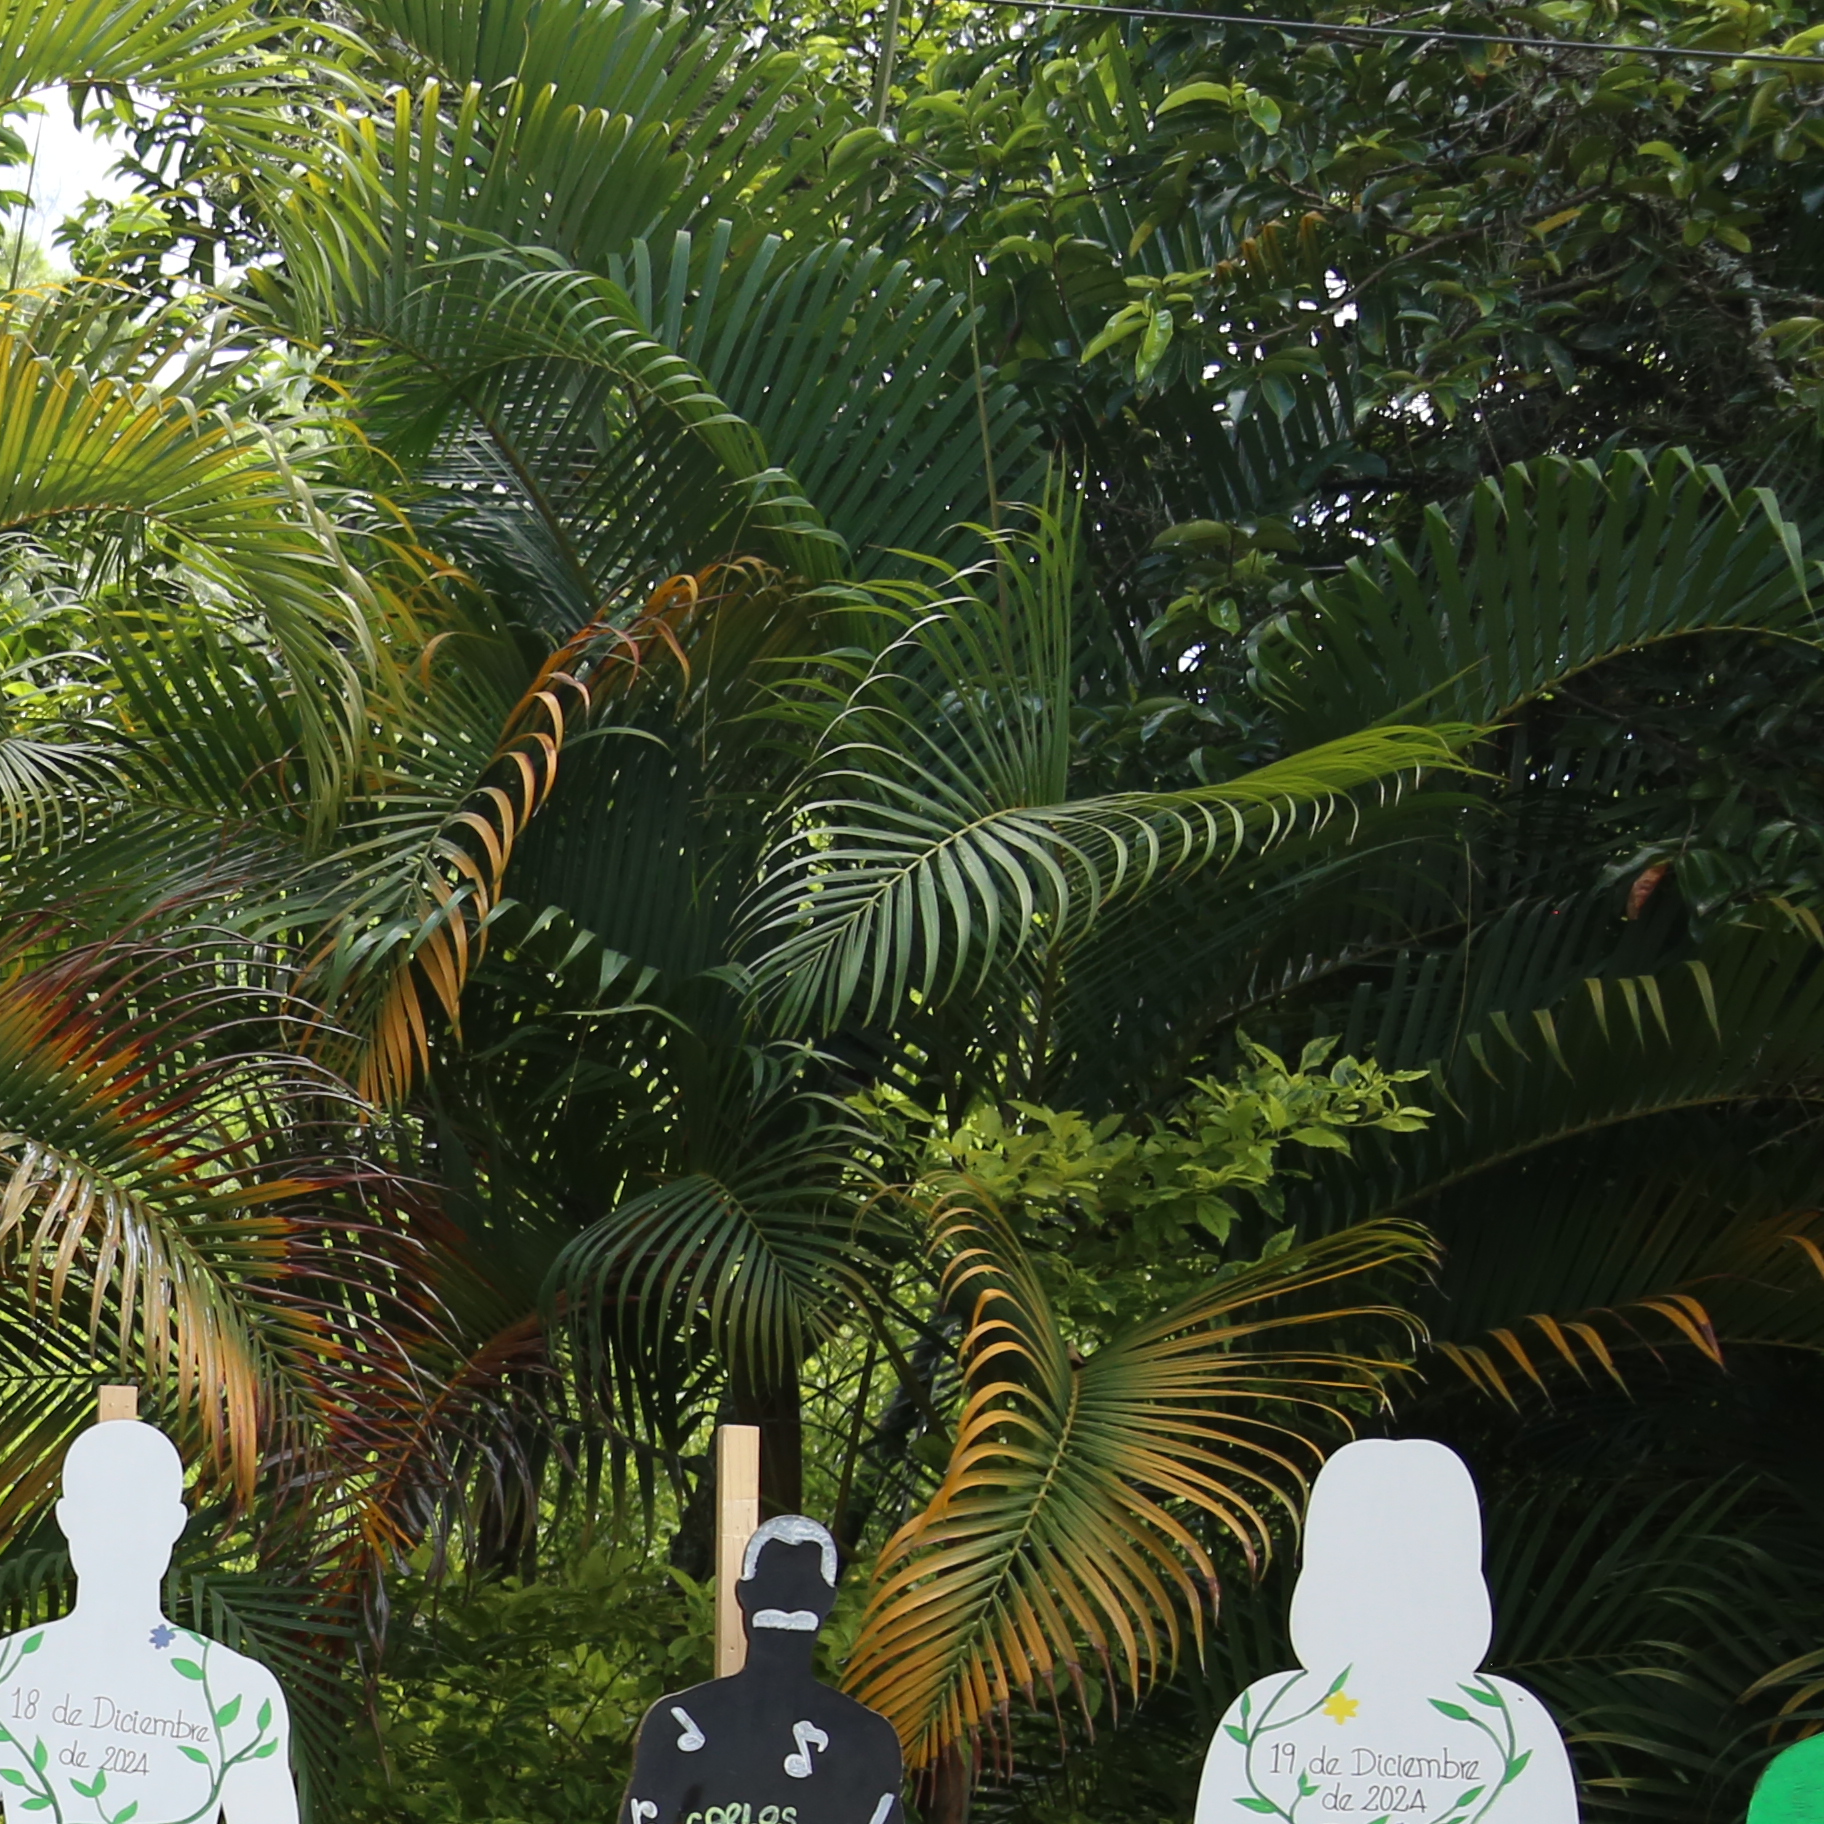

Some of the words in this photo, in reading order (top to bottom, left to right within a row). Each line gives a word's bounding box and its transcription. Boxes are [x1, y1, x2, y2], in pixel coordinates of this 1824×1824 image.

[11, 1687, 41, 1720] 18
[52, 1693, 84, 1727] de
[89, 1696, 211, 1743] Diciembre
[59, 1740, 90, 1769] de
[98, 1745, 151, 1777] 2024
[1269, 1742, 1297, 1775] 19
[1309, 1745, 1342, 1777] de
[1350, 1747, 1481, 1781] Diciembre
[1321, 1784, 1352, 1812] de
[1361, 1786, 1428, 1814] 2024
